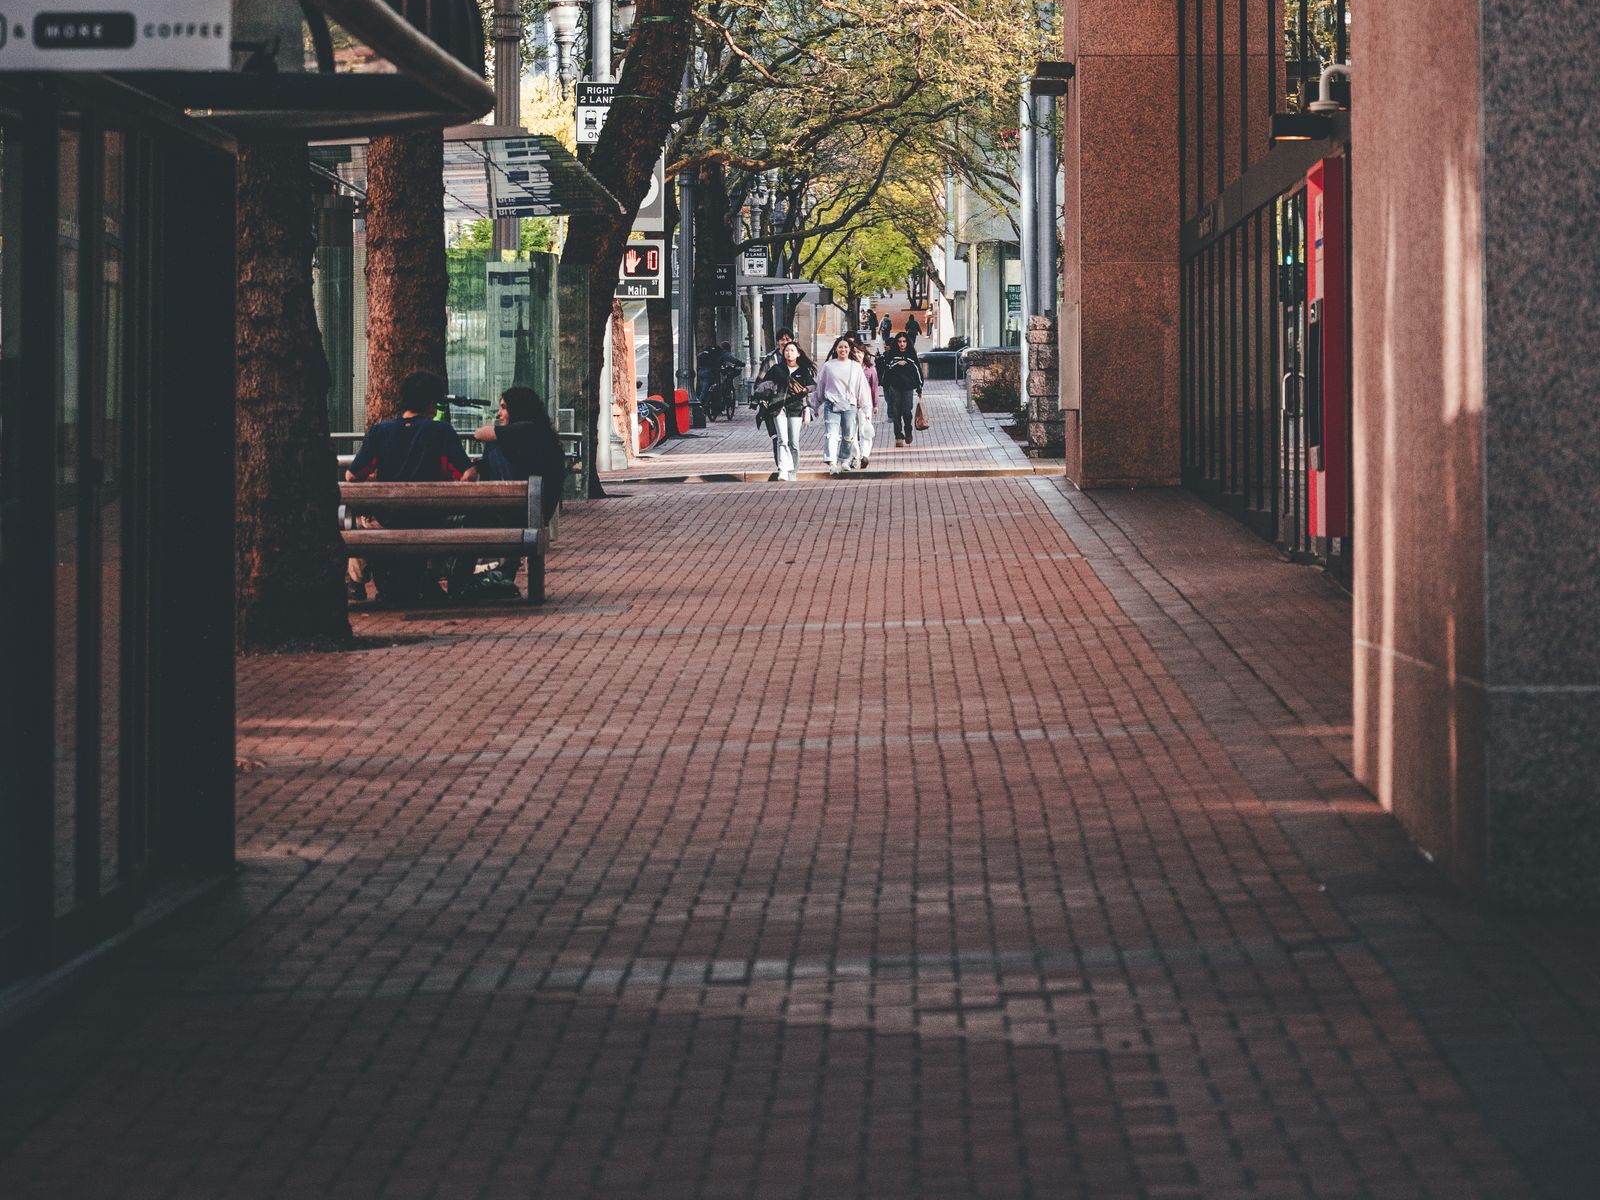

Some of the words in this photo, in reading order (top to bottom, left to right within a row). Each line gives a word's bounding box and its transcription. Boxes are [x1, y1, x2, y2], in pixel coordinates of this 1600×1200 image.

[45, 23, 103, 40] MORE
[143, 22, 224, 40] COFFEE
[647, 250, 657, 270] 10
[628, 284, 647, 295] Main
